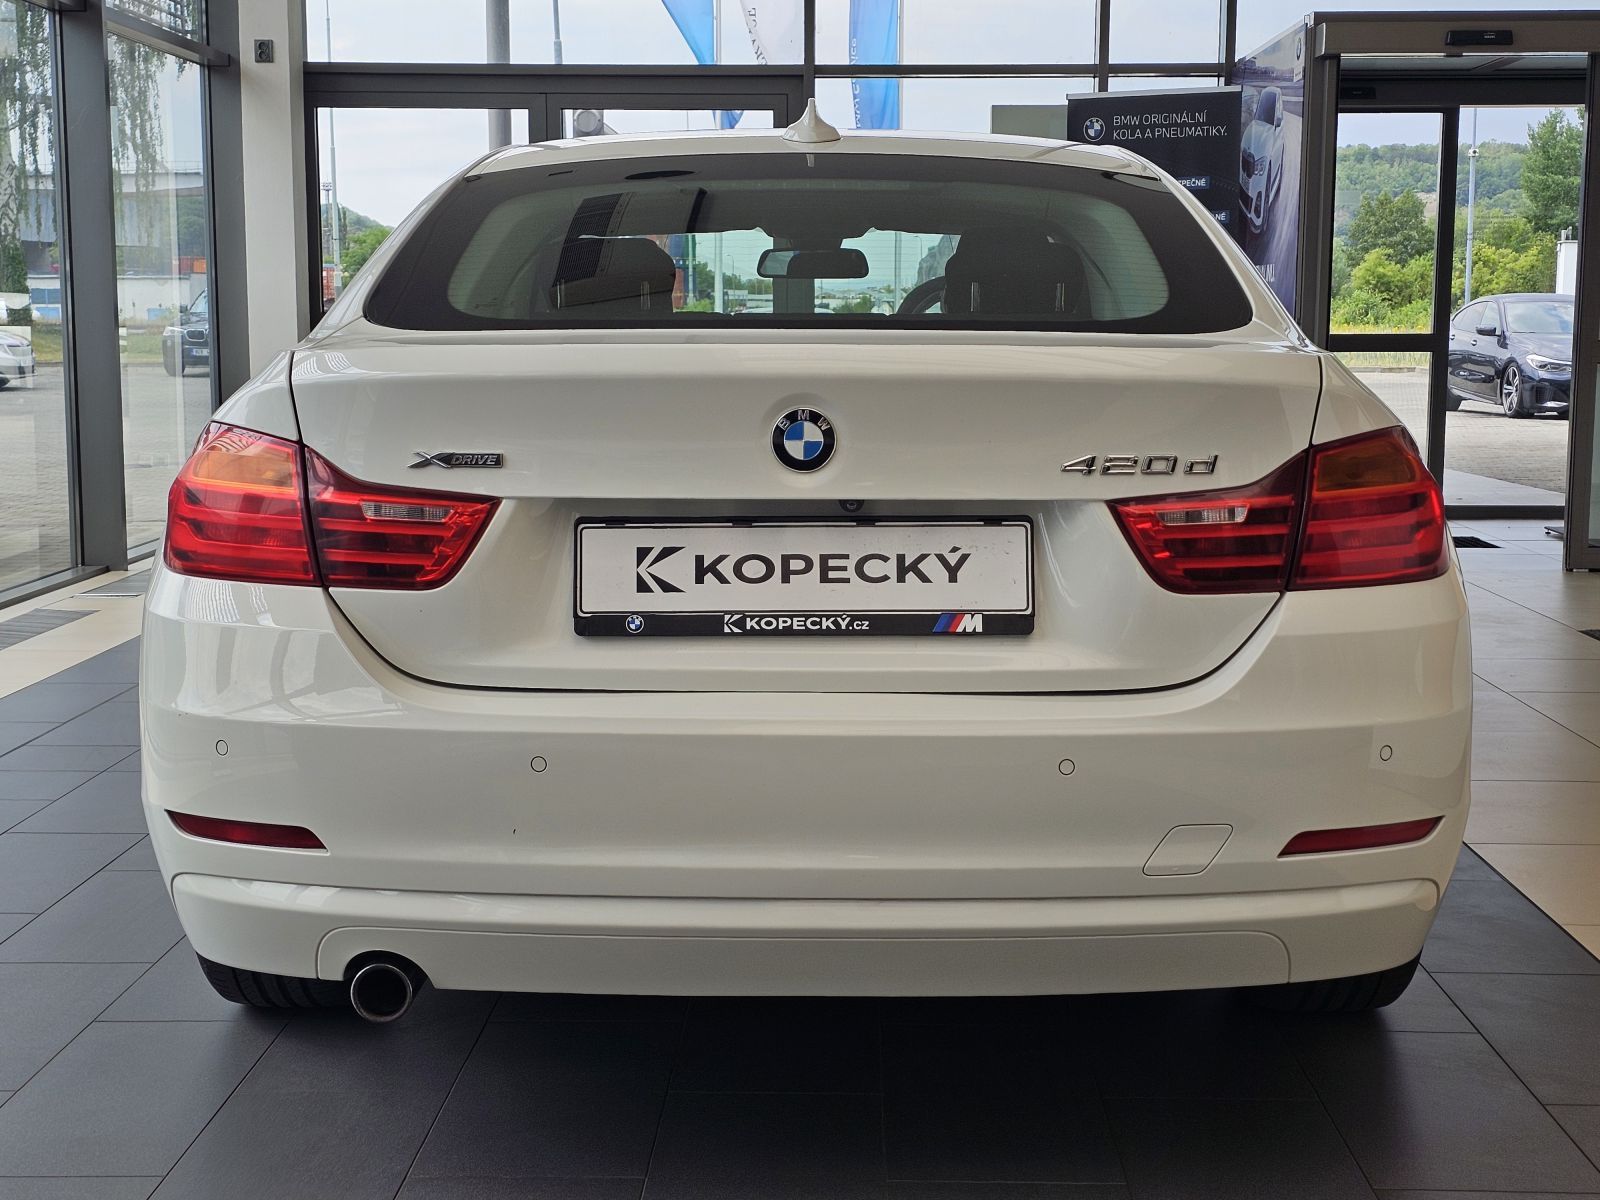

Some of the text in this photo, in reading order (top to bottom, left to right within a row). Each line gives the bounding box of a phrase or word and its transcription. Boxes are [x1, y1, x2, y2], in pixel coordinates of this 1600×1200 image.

[1113, 110, 1207, 126] BMW ORIGINÁLNÍ
[1113, 125, 1228, 140] KOLA A PNEUMATIKY.
[777, 409, 831, 431] BMW
[694, 546, 971, 585] KOPECKÝ
[746, 614, 869, 630] KOPECKÝ.cz
[956, 613, 983, 633] M
